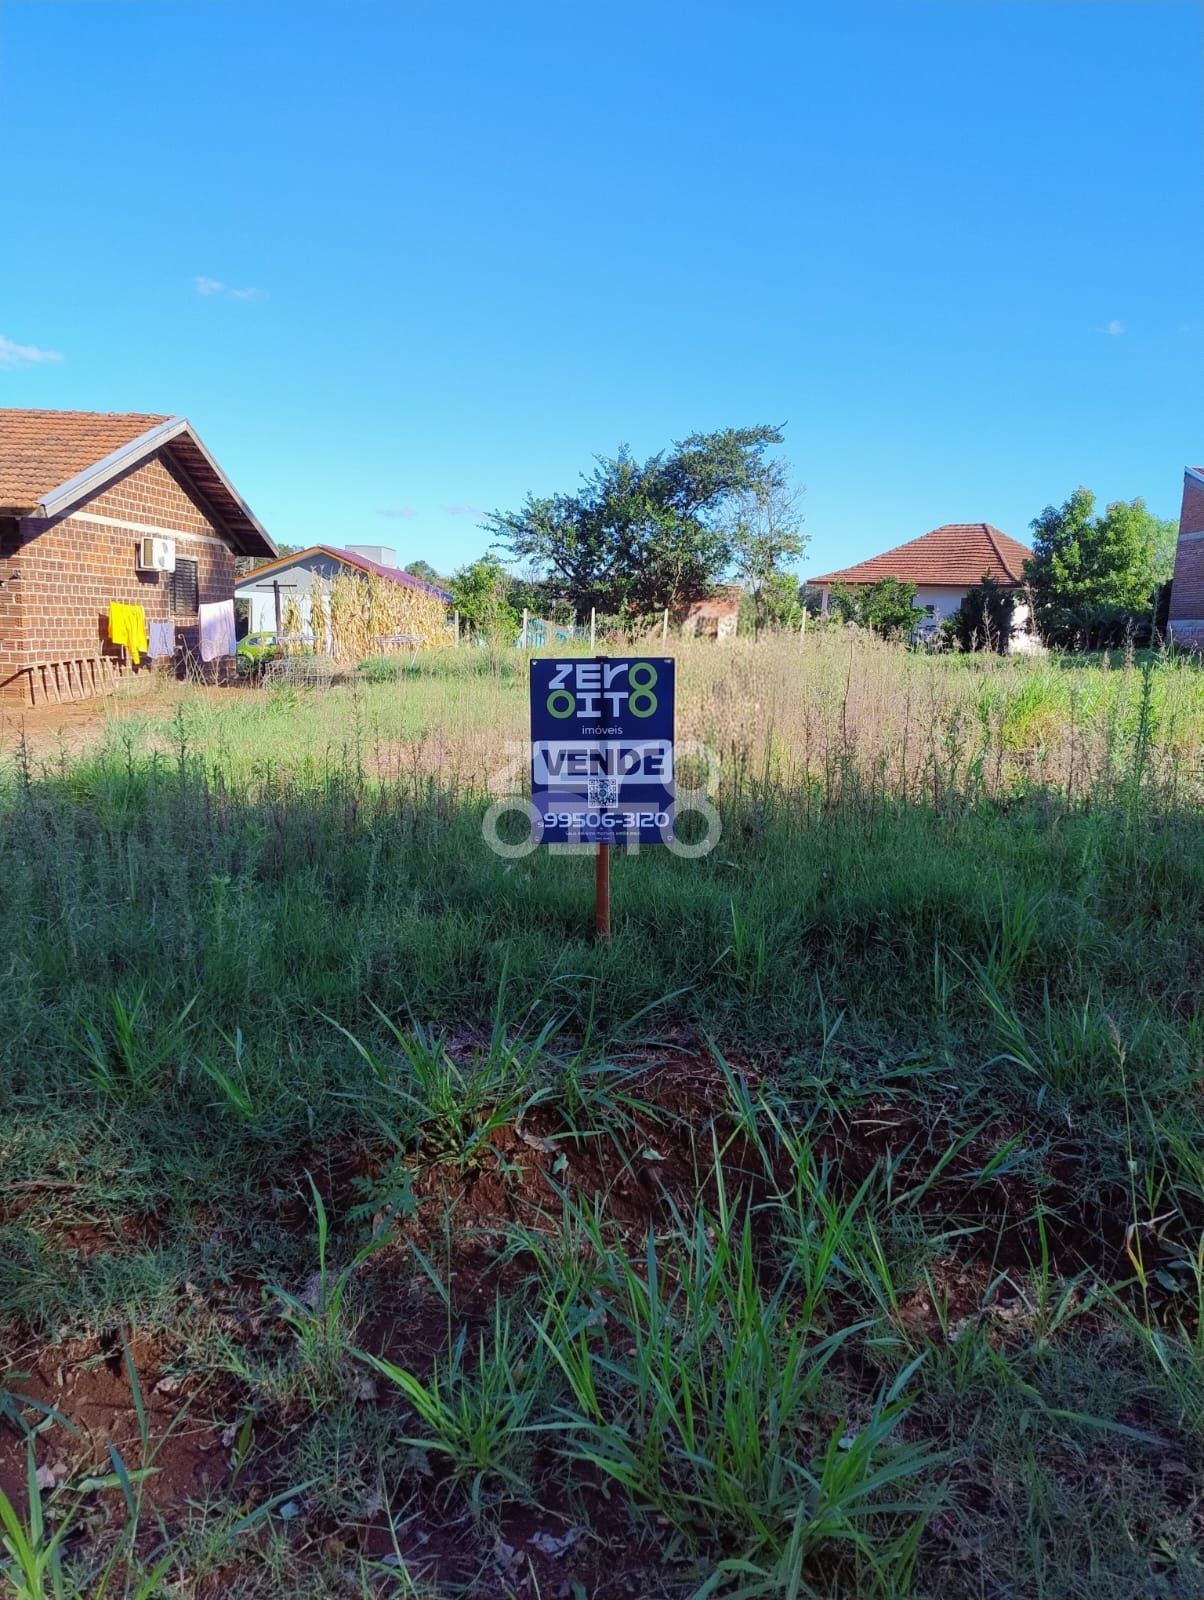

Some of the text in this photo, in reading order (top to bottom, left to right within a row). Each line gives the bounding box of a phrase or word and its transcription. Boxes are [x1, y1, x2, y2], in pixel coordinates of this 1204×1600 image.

[546, 690, 658, 718] OITO
[581, 724, 624, 735] imóveis
[540, 748, 665, 776] VENDE
[543, 812, 670, 828] 99506-3120
